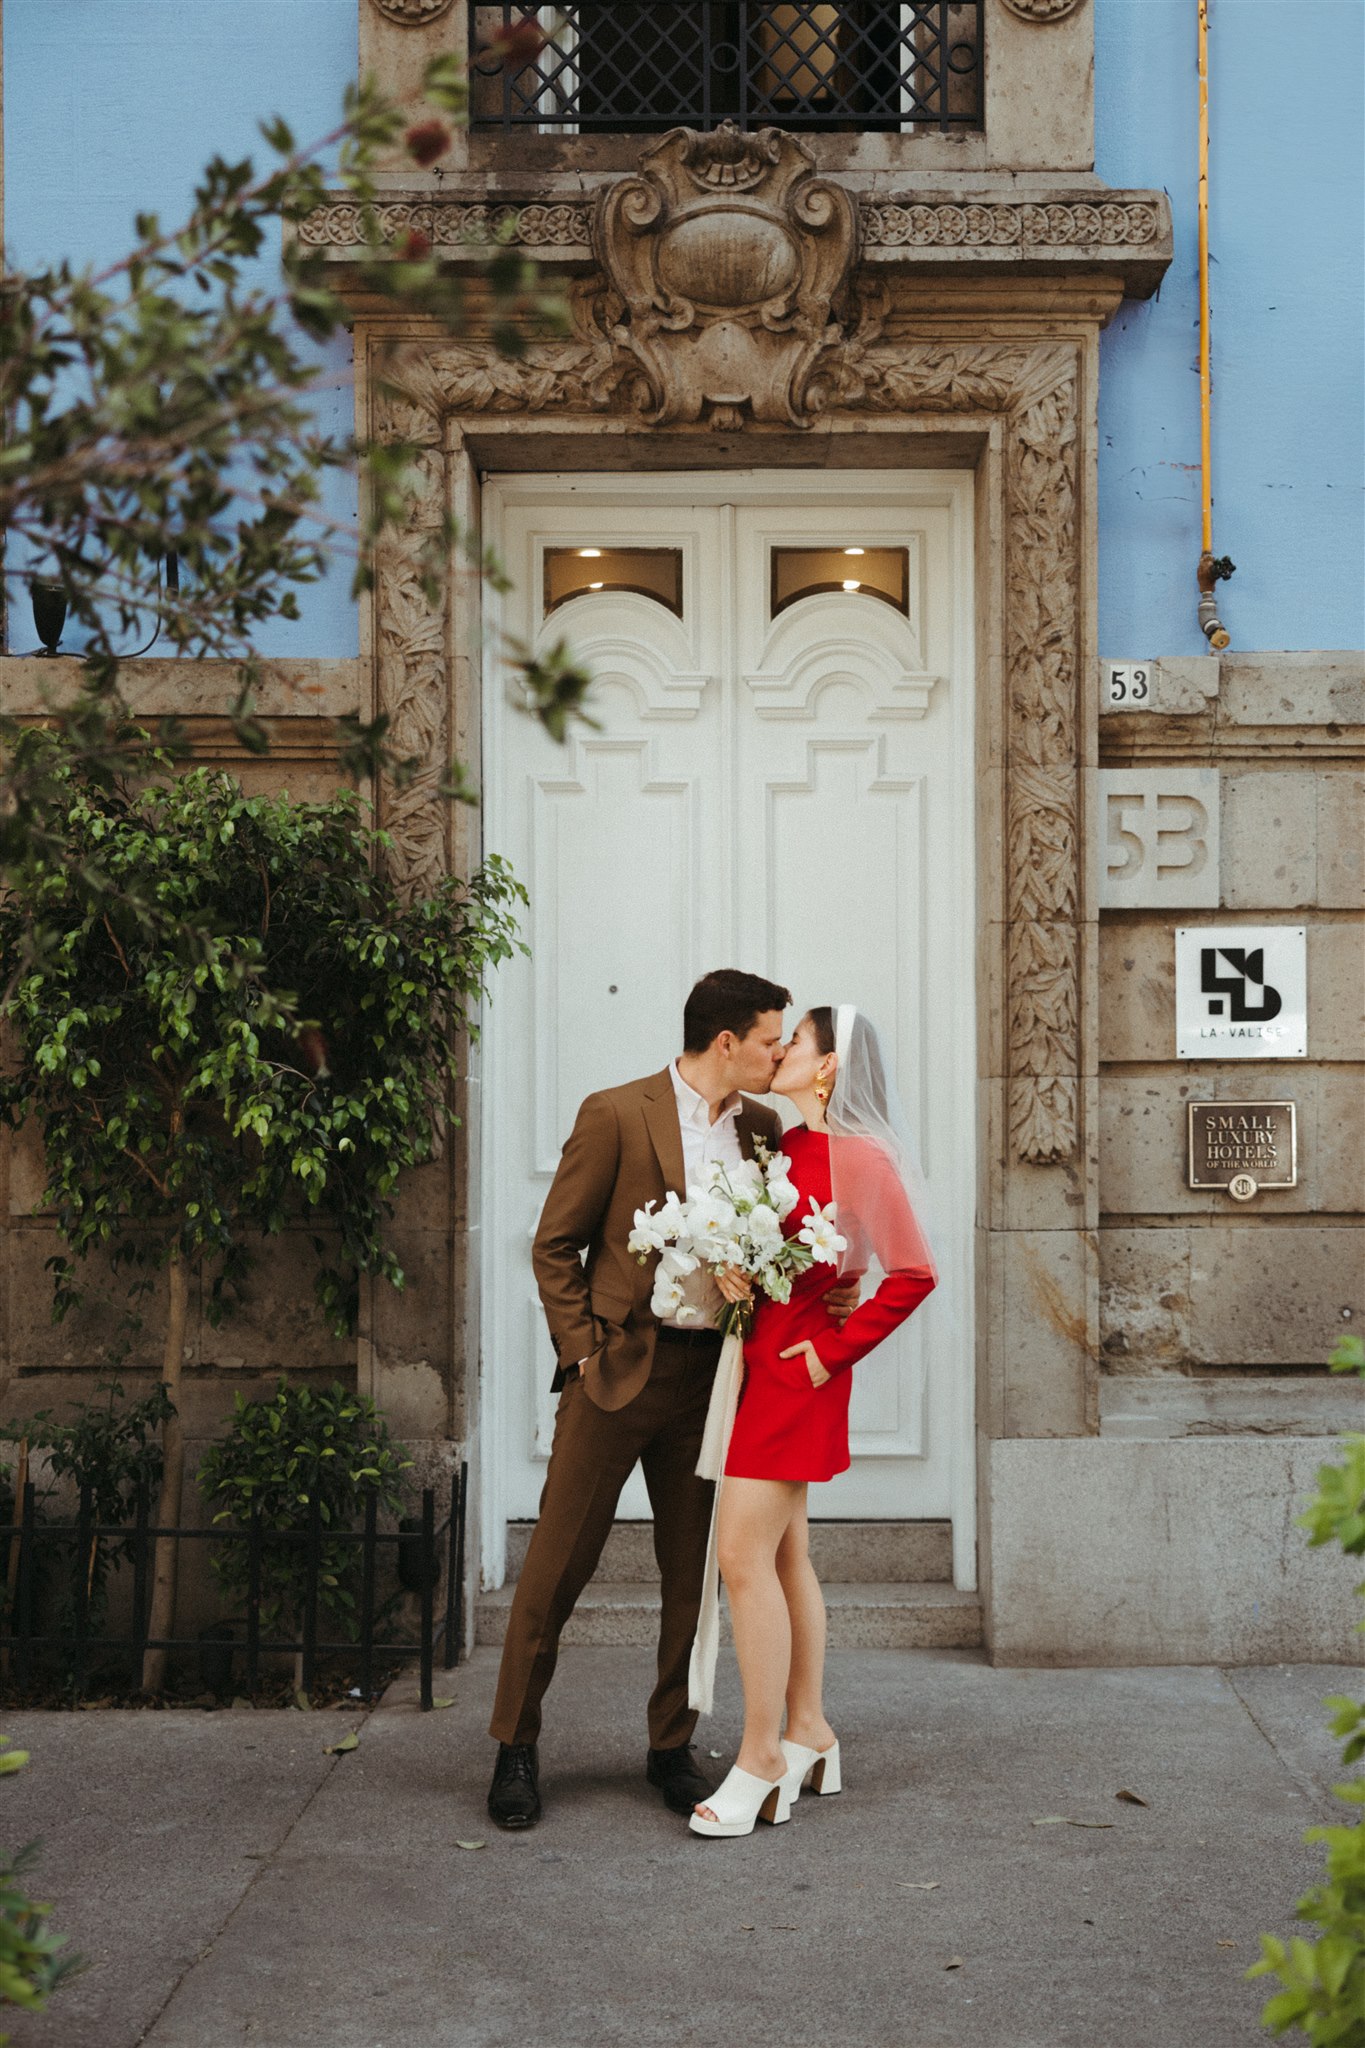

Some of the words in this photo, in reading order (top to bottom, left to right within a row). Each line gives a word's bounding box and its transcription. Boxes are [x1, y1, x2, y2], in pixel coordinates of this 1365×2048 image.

[1111, 671, 1147, 700] 53
[1107, 794, 1208, 881] 53
[1206, 1116, 1276, 1129] SMALL
[1207, 1131, 1275, 1144] LUXURY
[1207, 1145, 1277, 1159] HOTELS
[1206, 1160, 1220, 1168] OF
[1221, 1160, 1240, 1168] THE
[1242, 1160, 1277, 1168] WORLD
